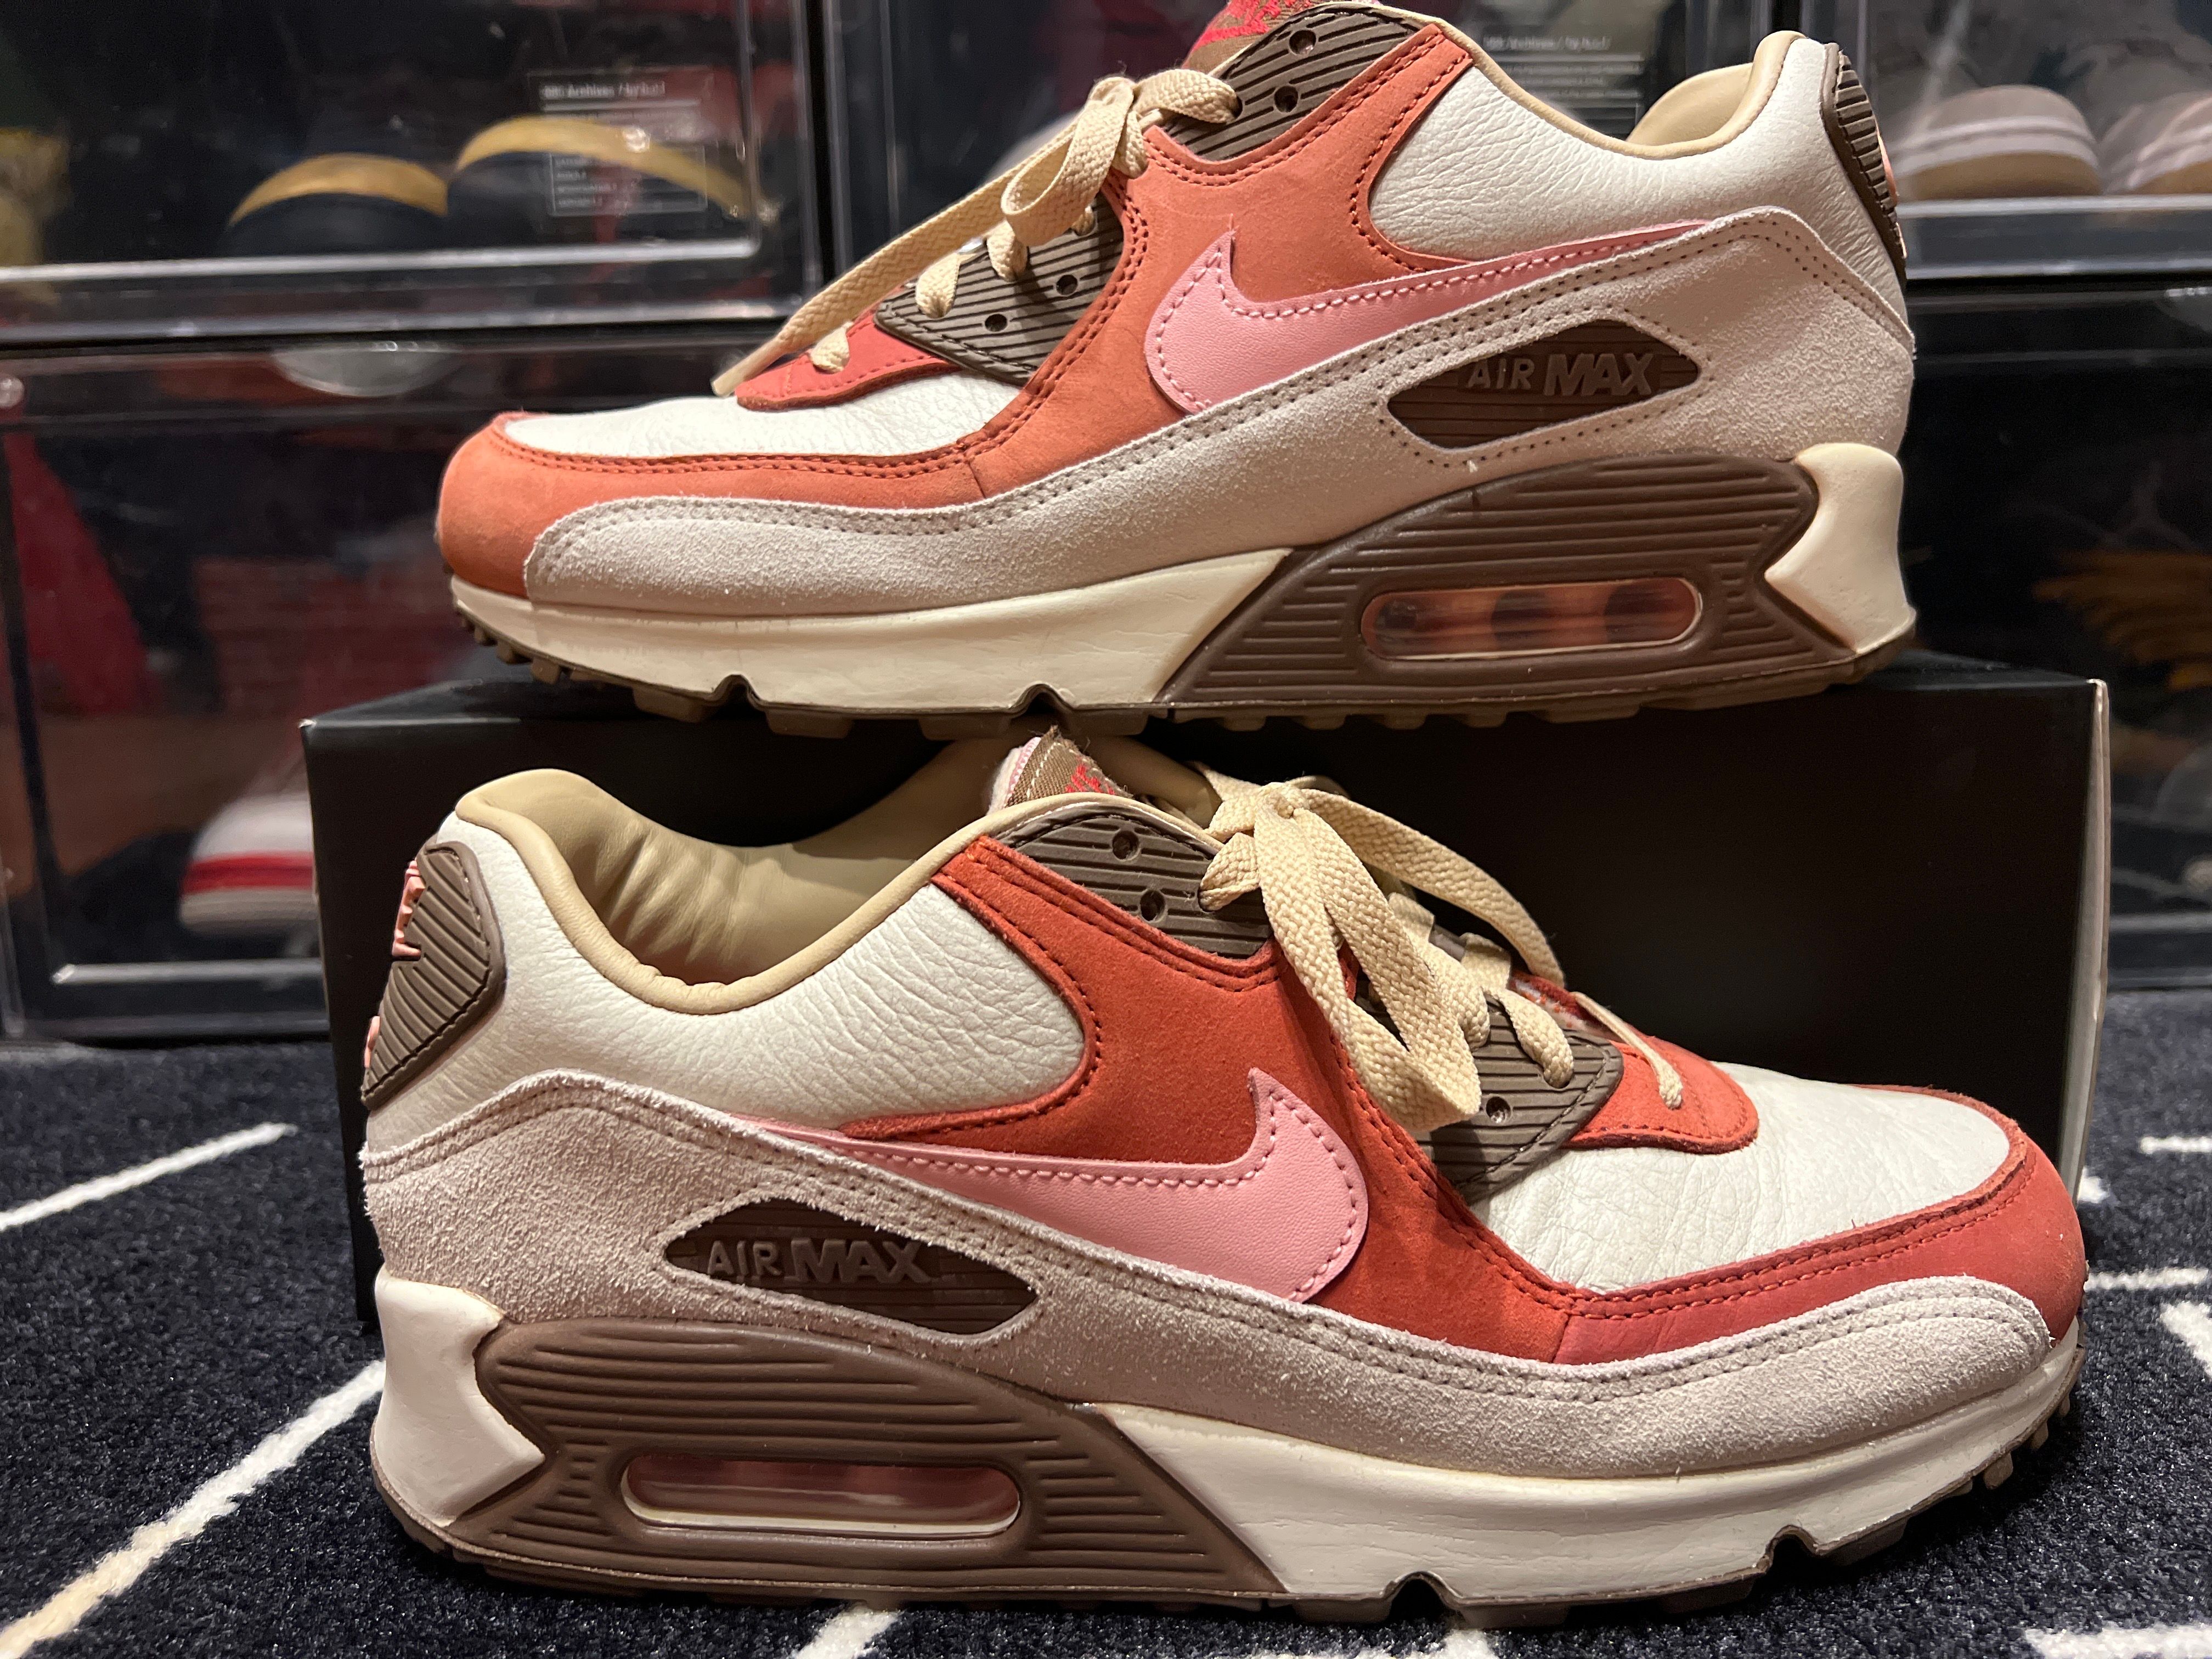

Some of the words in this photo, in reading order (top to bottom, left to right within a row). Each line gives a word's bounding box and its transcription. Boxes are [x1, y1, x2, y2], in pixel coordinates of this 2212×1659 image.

[1466, 358, 1535, 389] AIR
[1543, 353, 1654, 397] MAX
[708, 1240, 782, 1276] AIR
[791, 1237, 932, 1283] MAX
